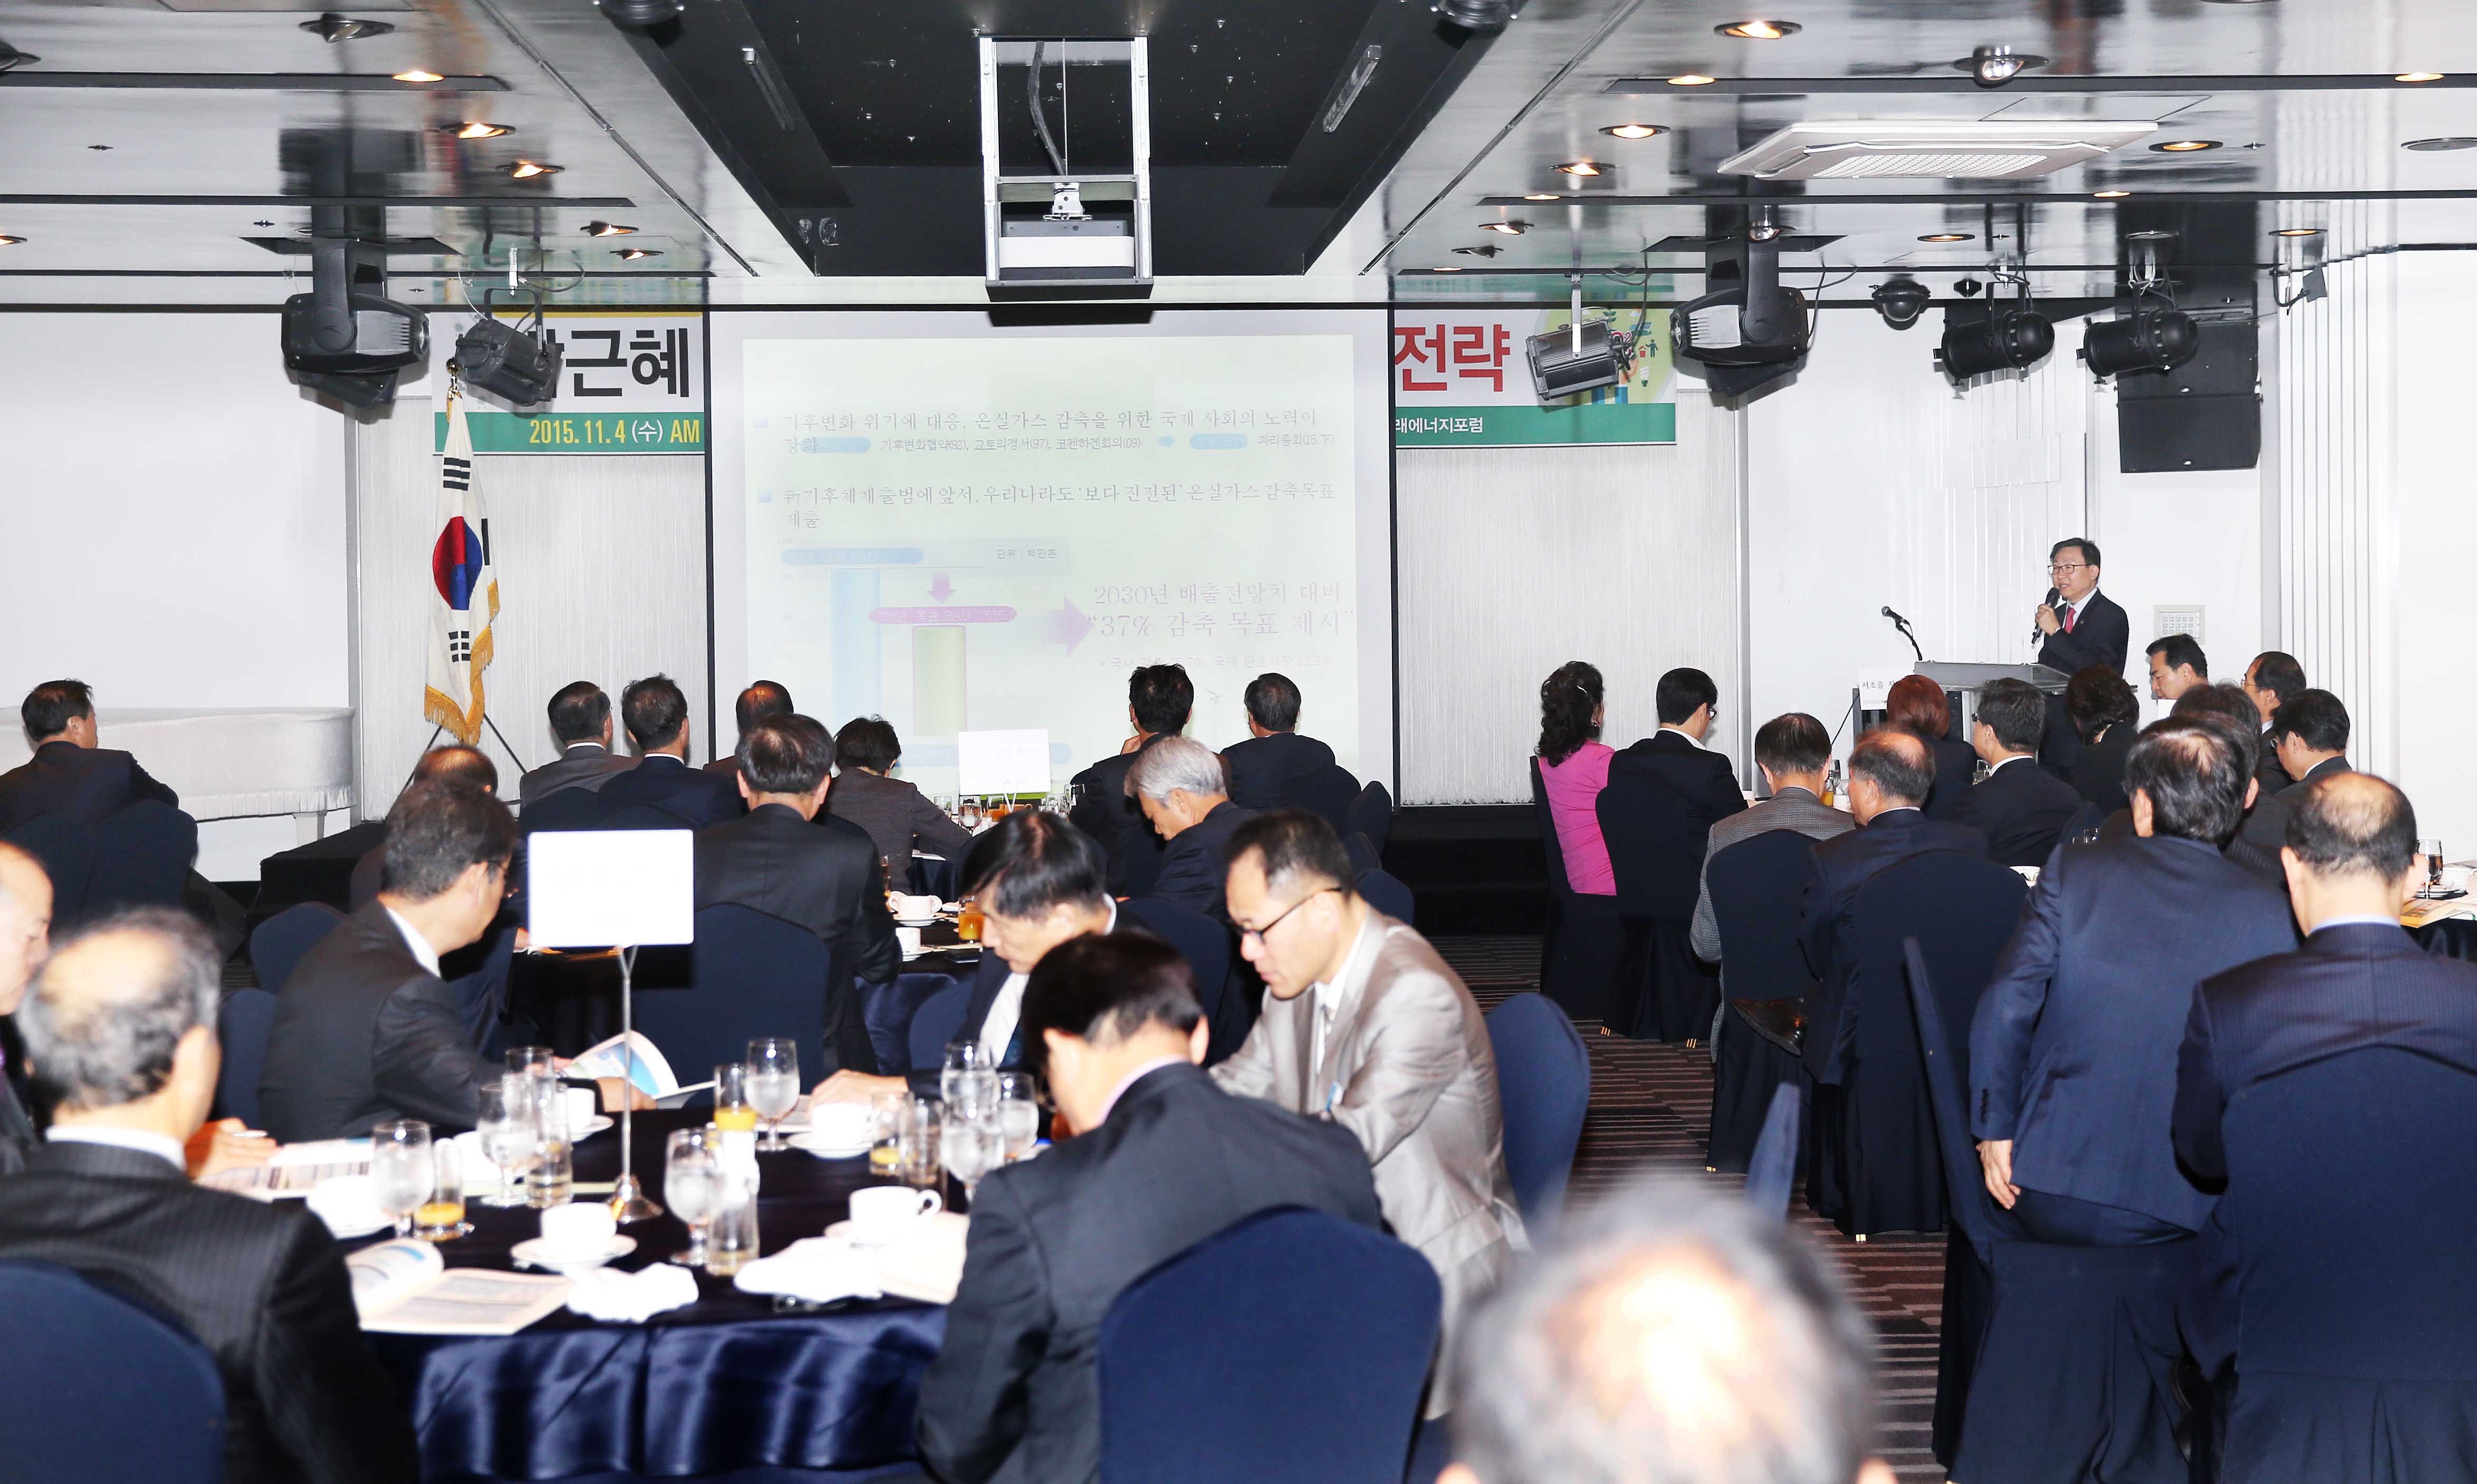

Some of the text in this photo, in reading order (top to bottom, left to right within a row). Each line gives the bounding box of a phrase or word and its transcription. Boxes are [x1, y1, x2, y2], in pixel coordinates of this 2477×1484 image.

[1395, 324, 1510, 392] 전략
[784, 413, 856, 431] 기후변화
[865, 412, 916, 430] 위기에
[974, 411, 1047, 430] 온실가스
[1055, 411, 1108, 429] 감축을
[1117, 410, 1151, 428] 위한
[1160, 409, 1193, 427] 국제
[1204, 409, 1254, 427] 사회의
[1264, 409, 1315, 427] 노력이
[632, 420, 663, 443] (수)
[670, 420, 700, 443] AM
[1187, 483, 1259, 502] 온실가스
[786, 510, 819, 528] 제출
[1095, 582, 1339, 604] 2030년 배출전망치 대비
[1166, 612, 1216, 637] 감축
[1227, 611, 1279, 638] 목표
